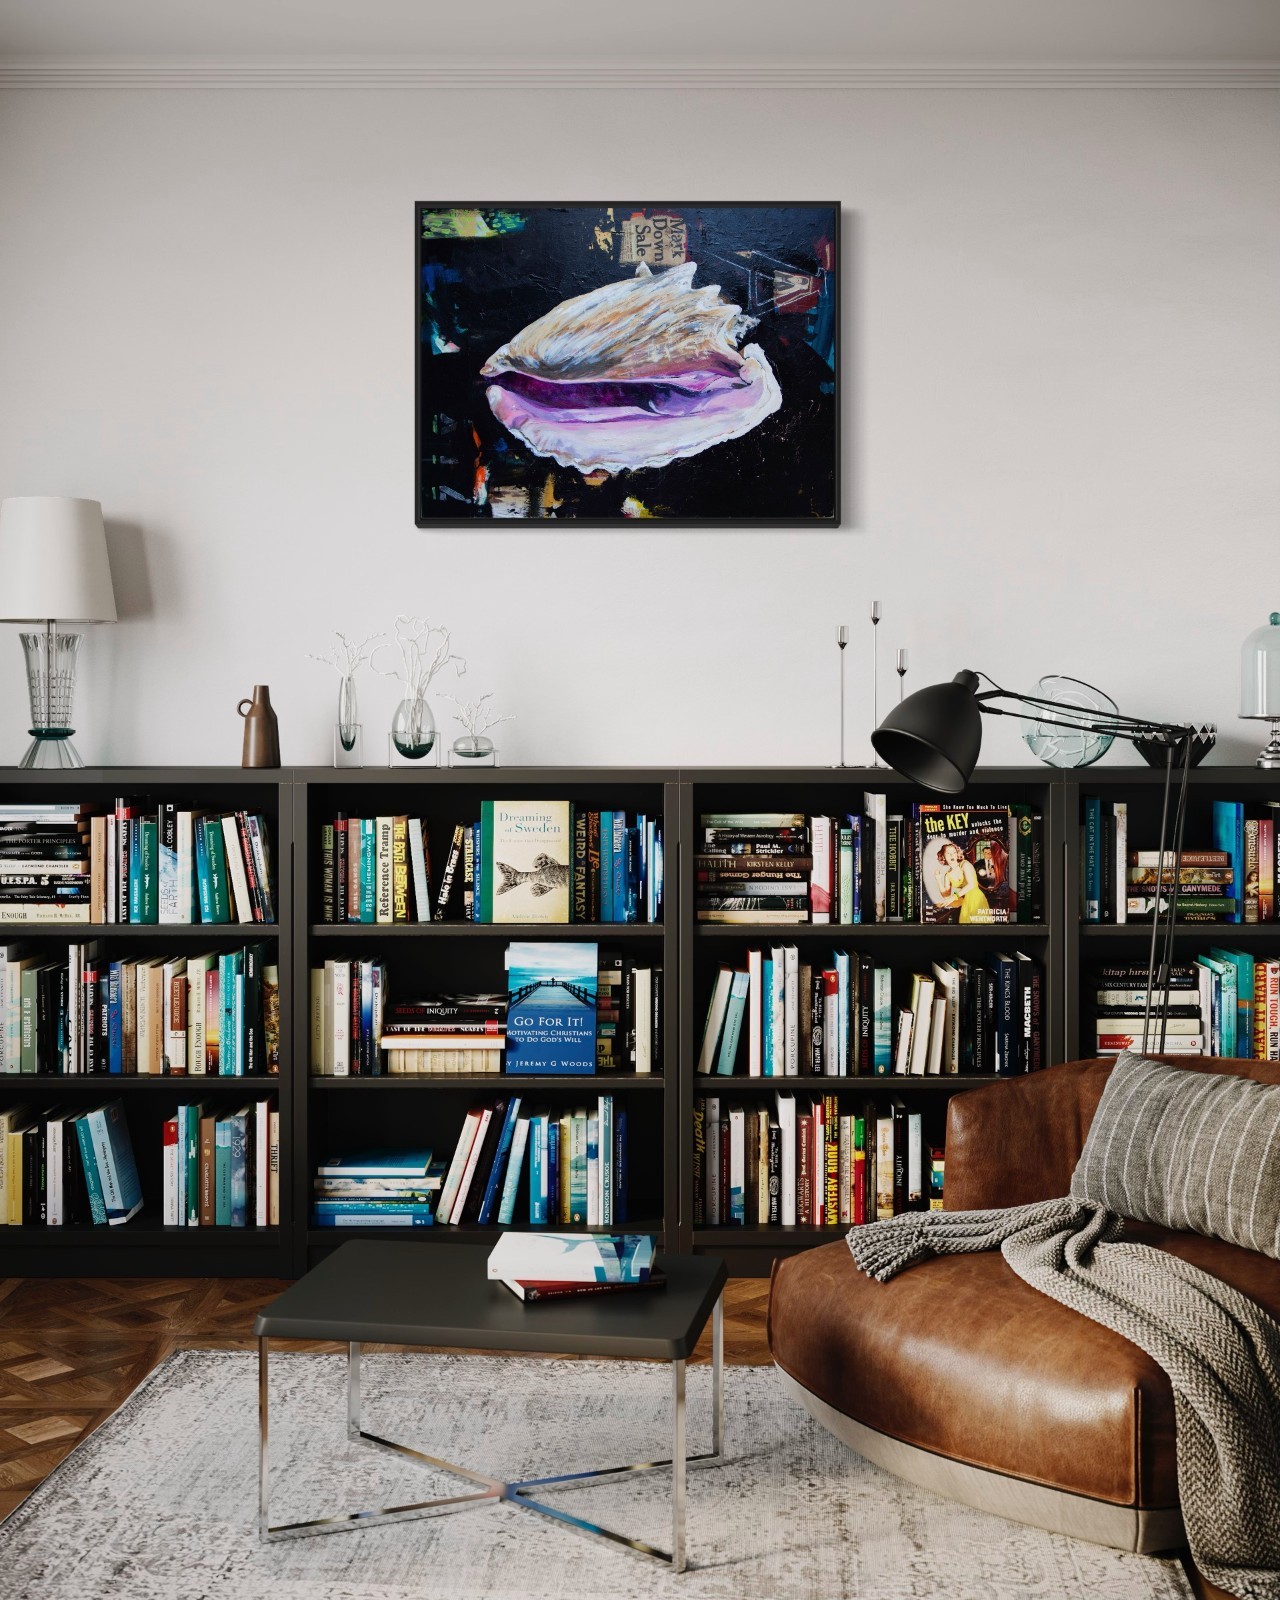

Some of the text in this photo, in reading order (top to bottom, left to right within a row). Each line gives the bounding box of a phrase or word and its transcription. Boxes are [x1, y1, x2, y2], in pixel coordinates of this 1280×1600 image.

[635, 225, 652, 257] Sale
[652, 218, 668, 263] Down
[671, 218, 685, 259] Mark
[166, 819, 174, 844] COBLEY
[499, 812, 553, 823] Dreaming
[514, 823, 561, 833] Sweden
[924, 816, 945, 834] the
[946, 812, 970, 831] KEY
[970, 820, 992, 829] unlocks
[948, 826, 1004, 838] murder violence
[814, 824, 824, 853] LILITH
[888, 826, 897, 872] THE HOBBIT
[1088, 808, 1096, 867] THE CAT IN THE HAT
[1246, 819, 1260, 870] Consuelo
[365, 835, 373, 883] HEMINGWAY
[379, 823, 391, 918] Reference Tramp
[394, 820, 407, 919] THE PATH BETWEEN
[463, 838, 474, 883] STAIRCASE
[575, 818, 586, 920] WEIRD FANTASY
[698, 859, 737, 869] HALITH
[1018, 868, 1026, 881] your
[41, 875, 50, 886] 5
[323, 849, 333, 922] THIS WOMAN IS MINE
[437, 848, 460, 906] Halo in Brass
[751, 872, 784, 880] Hunger
[1181, 885, 1222, 893] GANYMEDE
[2, 911, 28, 920] ENOUGH
[160, 888, 169, 915] SEEDS
[976, 908, 1008, 916] PATRICIA
[969, 915, 1008, 923] WENTWORTH
[1102, 967, 1126, 977] kitap
[173, 981, 181, 1025] BEETLEJUICE
[1032, 974, 1041, 1017] THE SNOWS
[1254, 962, 1266, 1025] HARD IT
[101, 1004, 109, 1037] PATRIOTS
[394, 1007, 416, 1015] SEEDS
[426, 1007, 459, 1016] INIQUITY
[861, 1005, 871, 1038] INIQUITY
[1023, 986, 1032, 1038] MACBETH
[1269, 977, 1279, 1048] RUN TOUGH, RUN
[23, 1016, 32, 1048] architecture
[194, 1022, 202, 1048] ENOUGH
[194, 1049, 202, 1073] ROUGH
[515, 1060, 547, 1068] JEREMY
[231, 1135, 242, 1158] 1929
[694, 1110, 706, 1153] Death
[270, 1143, 279, 1173] THRIFT
[693, 1152, 701, 1178] WISH
[895, 1155, 905, 1188] INIQUITY
[204, 1162, 212, 1188] CHARLOTTE
[603, 1161, 611, 1224] ROBINSON CRUSOE
[797, 1177, 805, 1215] HOGWARTS
[826, 1175, 838, 1225] MYSTERY
